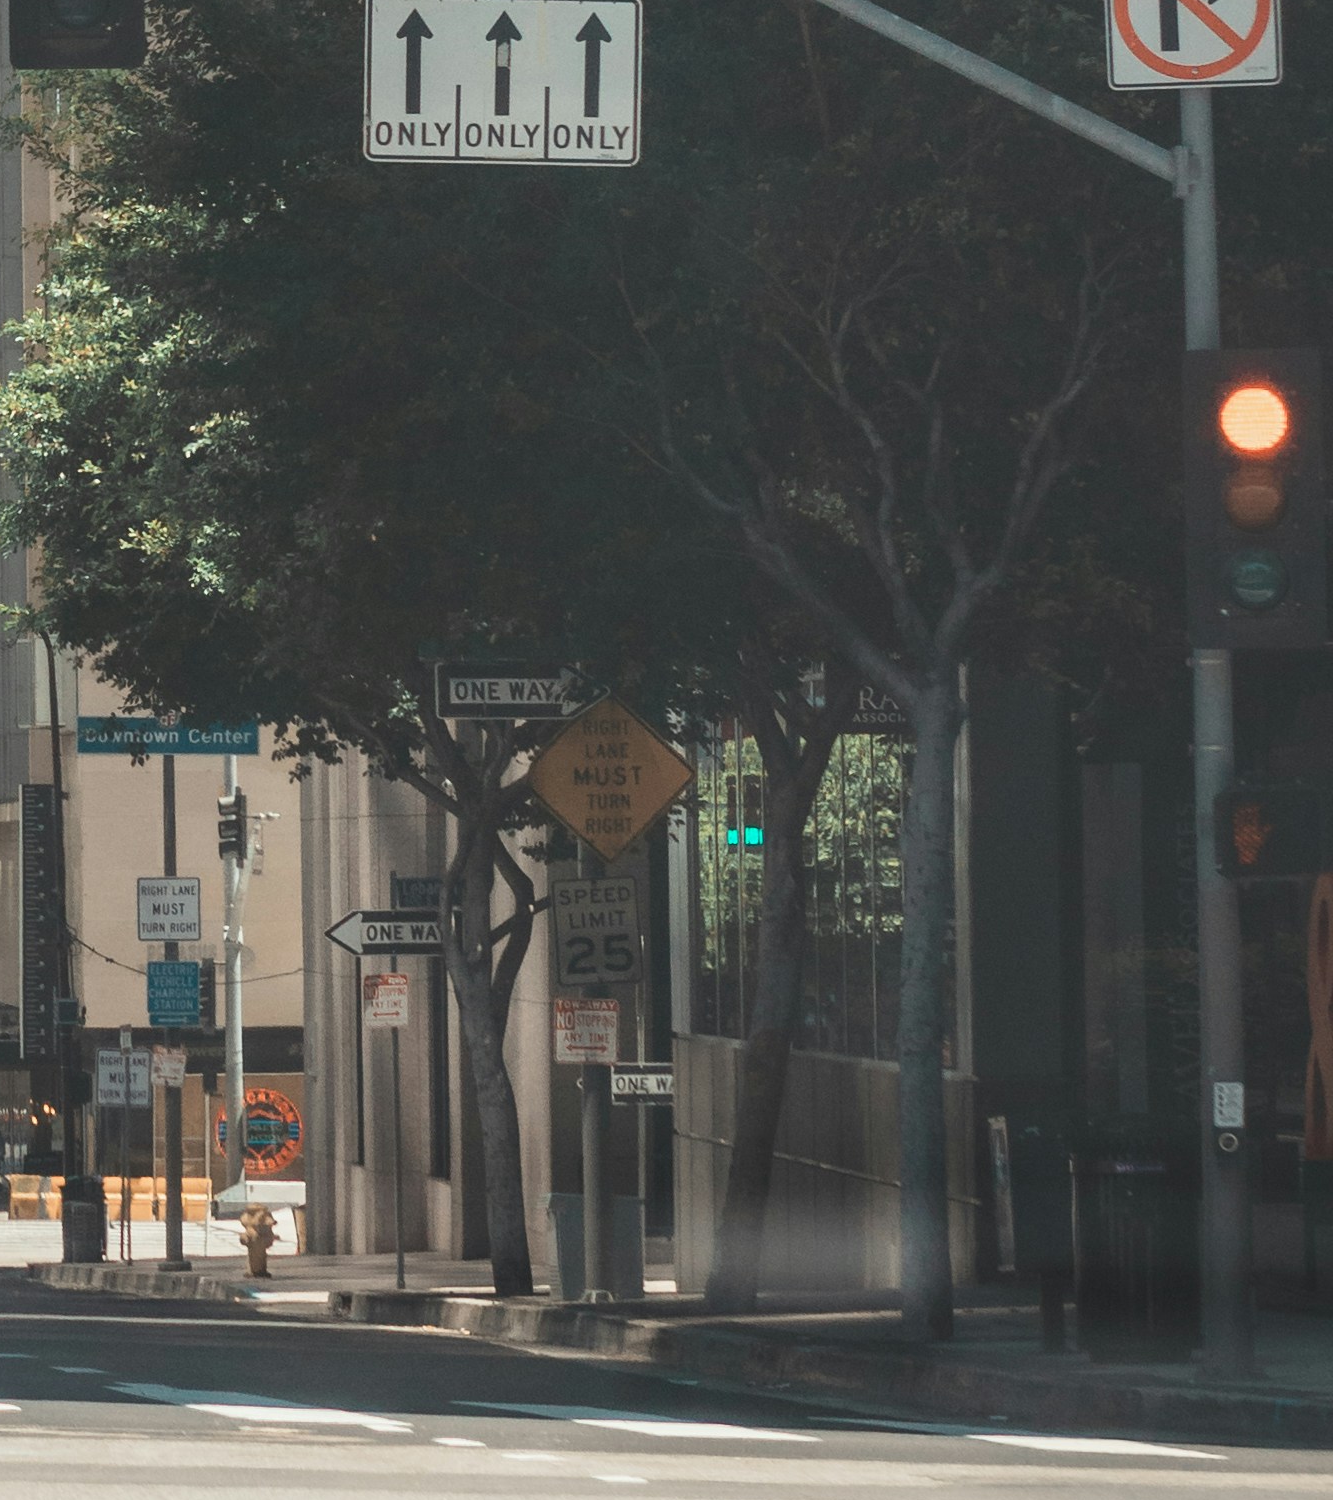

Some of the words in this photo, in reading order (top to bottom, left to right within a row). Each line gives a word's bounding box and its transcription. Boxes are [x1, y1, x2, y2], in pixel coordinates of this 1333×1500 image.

[375, 121, 452, 147] ONLY
[465, 123, 541, 148] ONLY
[553, 125, 630, 150] ONLY
[454, 681, 500, 701] ONE
[509, 681, 555, 701] WAY
[583, 719, 631, 735] RIGHT
[188, 729, 251, 744] Center
[584, 742, 629, 758] LANE
[573, 766, 642, 786] MUST
[587, 793, 631, 810] TURN
[585, 817, 632, 834] RIGHT
[141, 886, 168, 896] RIGHT
[171, 886, 196, 896] LANE
[559, 886, 630, 906] SPEED
[152, 903, 185, 915] MUST
[141, 922, 166, 933] TURN
[170, 922, 197, 933] RIGHT
[568, 911, 626, 929] LIMIT
[366, 925, 403, 941] ONE
[410, 925, 439, 941] WA
[565, 934, 634, 975] 25
[151, 965, 196, 975] ELECTRIC
[154, 977, 193, 986] VEHICLE
[149, 988, 198, 998] CHARGING
[154, 1000, 193, 1010] STATION
[557, 1012, 574, 1029] NO
[564, 1032, 582, 1041] ANY
[589, 1033, 610, 1043] TIME
[616, 1077, 649, 1091] ONE
